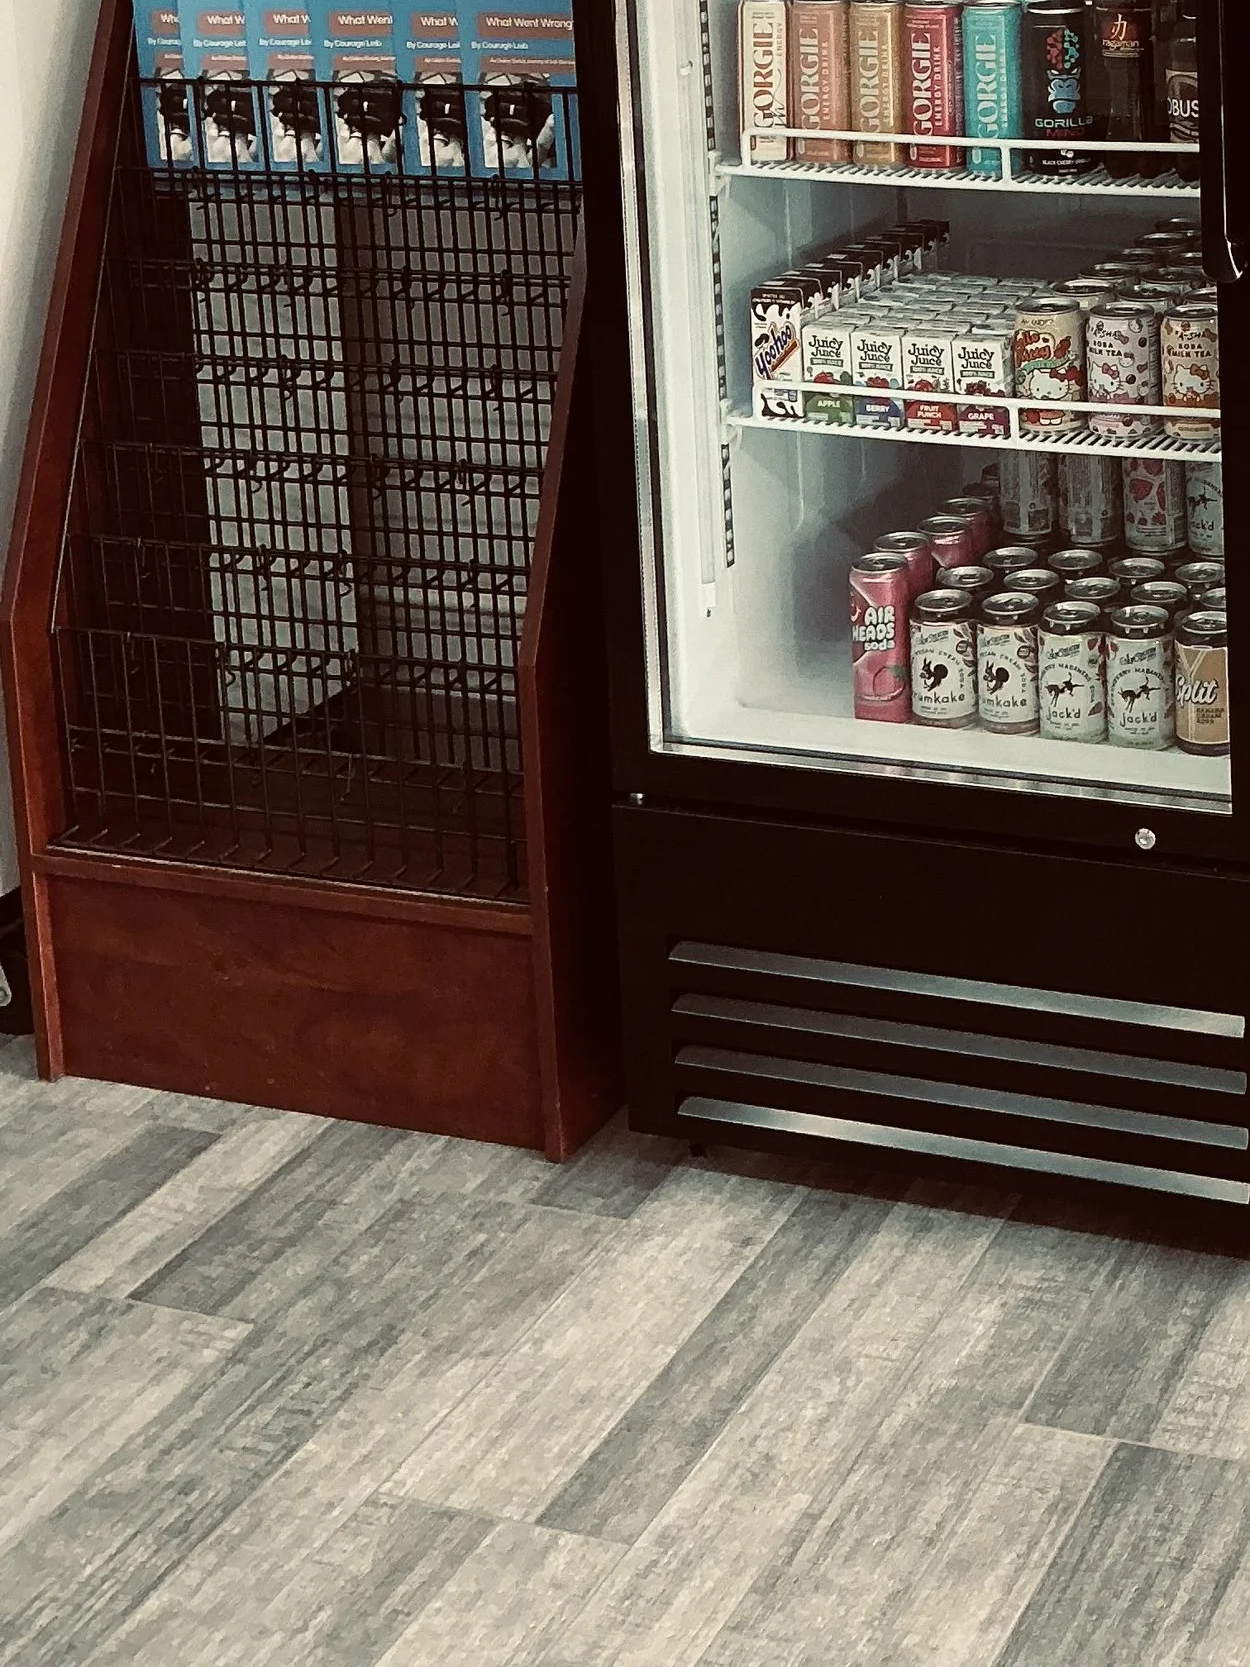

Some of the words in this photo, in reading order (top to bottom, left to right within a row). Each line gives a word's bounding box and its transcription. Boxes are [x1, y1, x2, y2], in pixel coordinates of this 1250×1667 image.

[338, 15, 364, 25] What
[367, 15, 393, 25] Went
[486, 16, 513, 27] What
[514, 17, 539, 28] Went
[541, 18, 573, 31] Wrong
[932, 45, 941, 80] DRINK
[753, 21, 774, 128] GORGIE
[799, 28, 821, 131] GORGIE
[859, 29, 881, 134] GORGIE
[912, 32, 934, 137] GORGIE
[975, 34, 1000, 139] GORGIE
[933, 82, 943, 127] ENERGY
[809, 335, 844, 351] Juicy
[856, 339, 893, 355] Juicy
[908, 343, 945, 359] Juicy
[811, 346, 841, 359] Juice
[860, 350, 890, 363] Juice
[911, 354, 942, 367] Juice
[957, 346, 995, 363] Juicy
[1193, 350, 1212, 358] TEA
[961, 358, 993, 370] Juice
[818, 399, 841, 408] APPLE
[866, 404, 890, 413] BERRY
[919, 404, 940, 413] FRUIT
[917, 410, 942, 419] PUNCH
[967, 412, 994, 421] GRAPE
[864, 605, 896, 626] AIR
[852, 621, 895, 642] HEADS
[864, 638, 896, 651] soda
[1175, 674, 1220, 707] Split
[1120, 710, 1158, 729] jack'd
